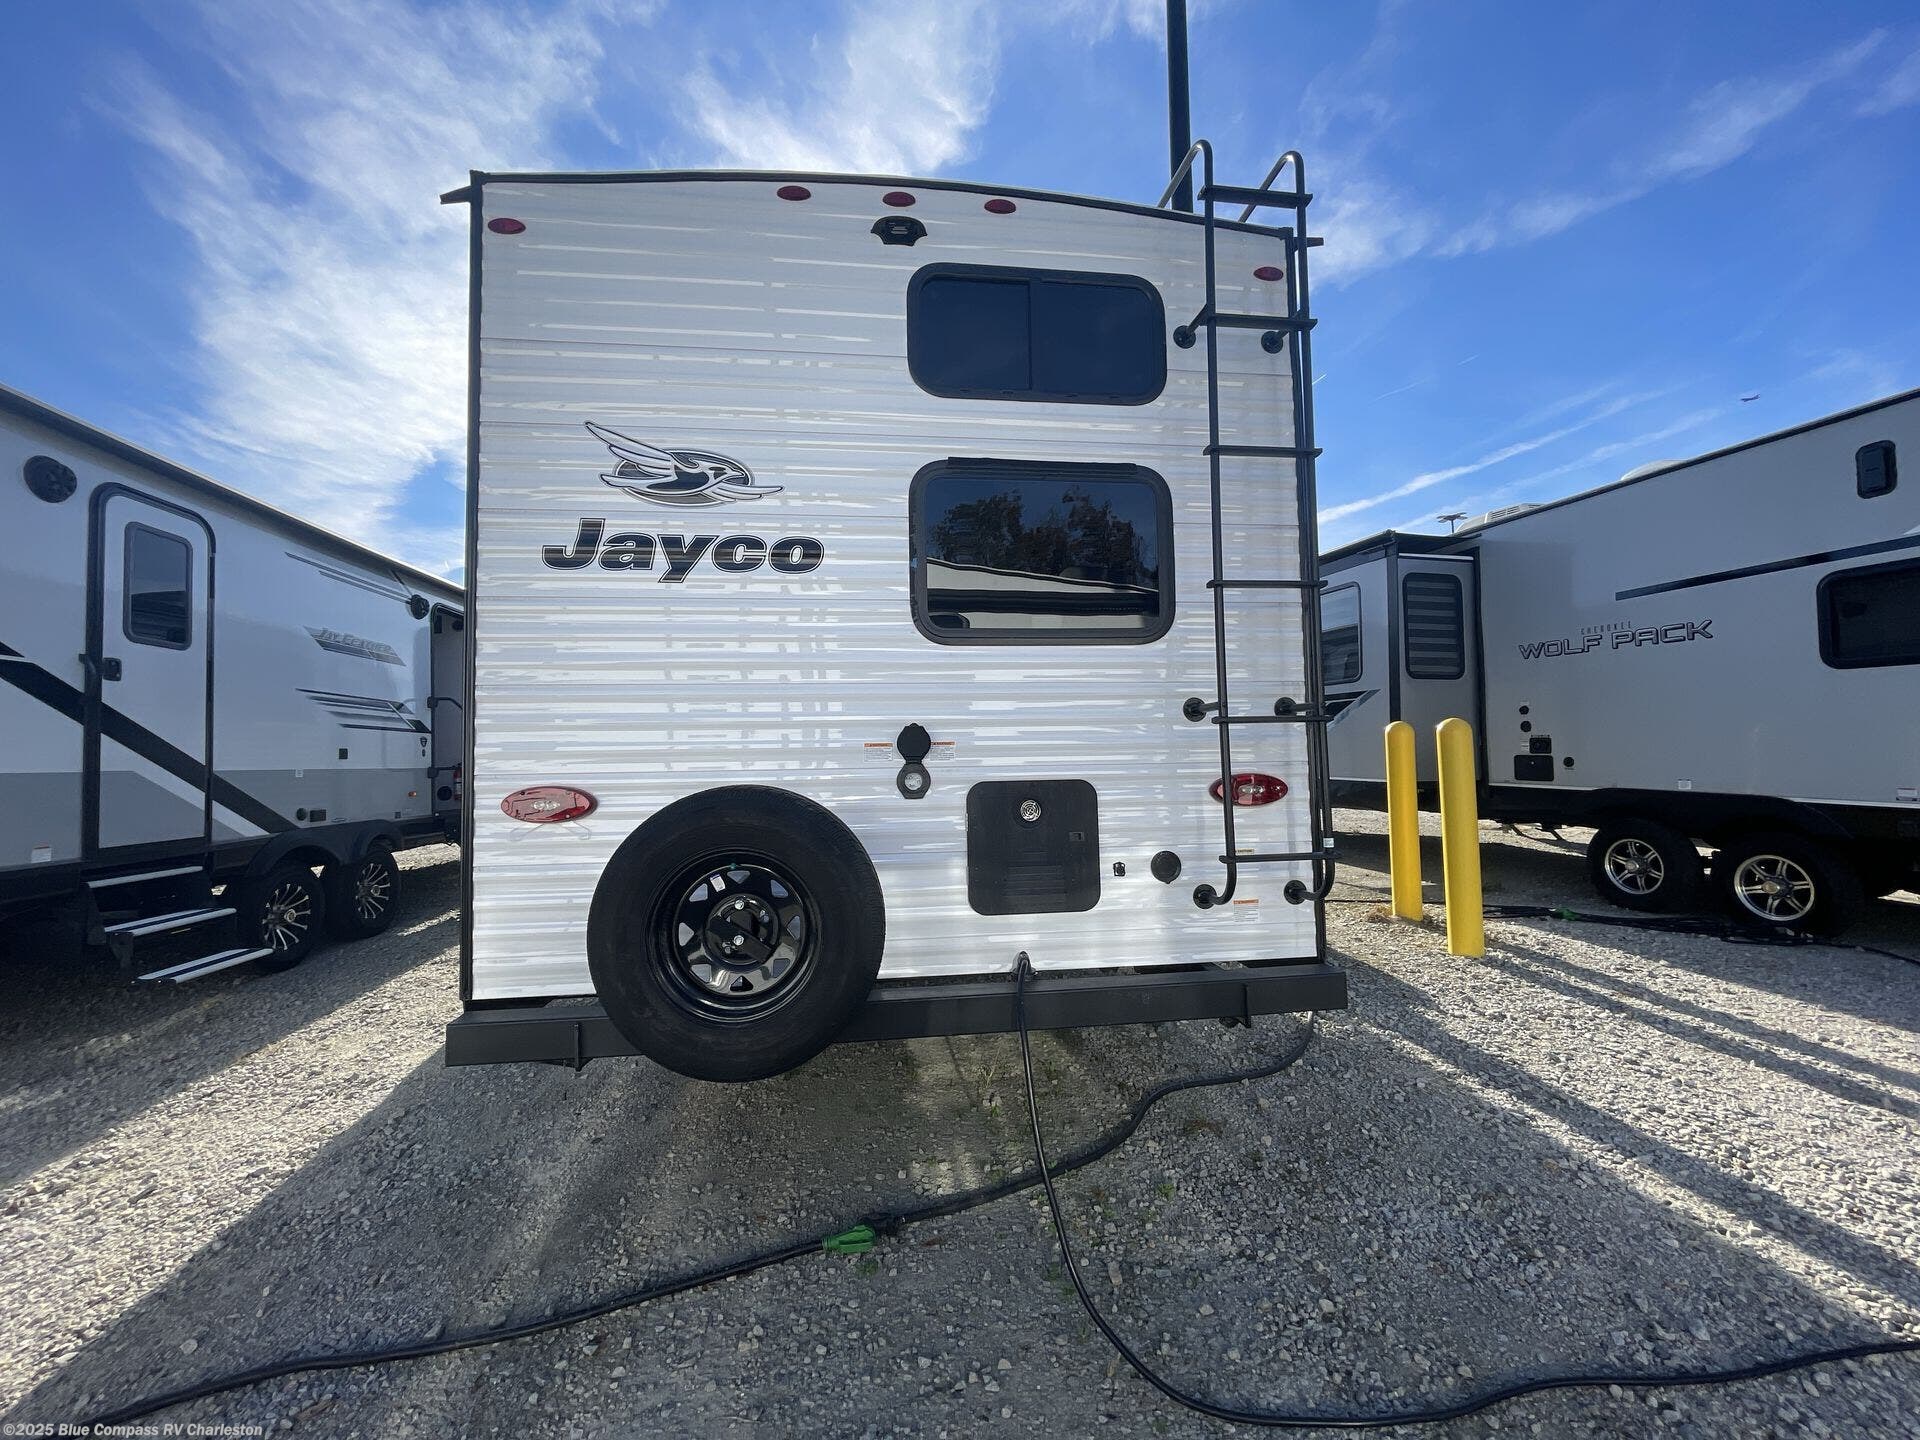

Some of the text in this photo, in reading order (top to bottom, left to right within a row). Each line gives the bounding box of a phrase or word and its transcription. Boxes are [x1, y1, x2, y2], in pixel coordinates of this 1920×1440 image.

[542, 517, 825, 584] Jayco
[1518, 619, 1714, 660] WOLF PACK
